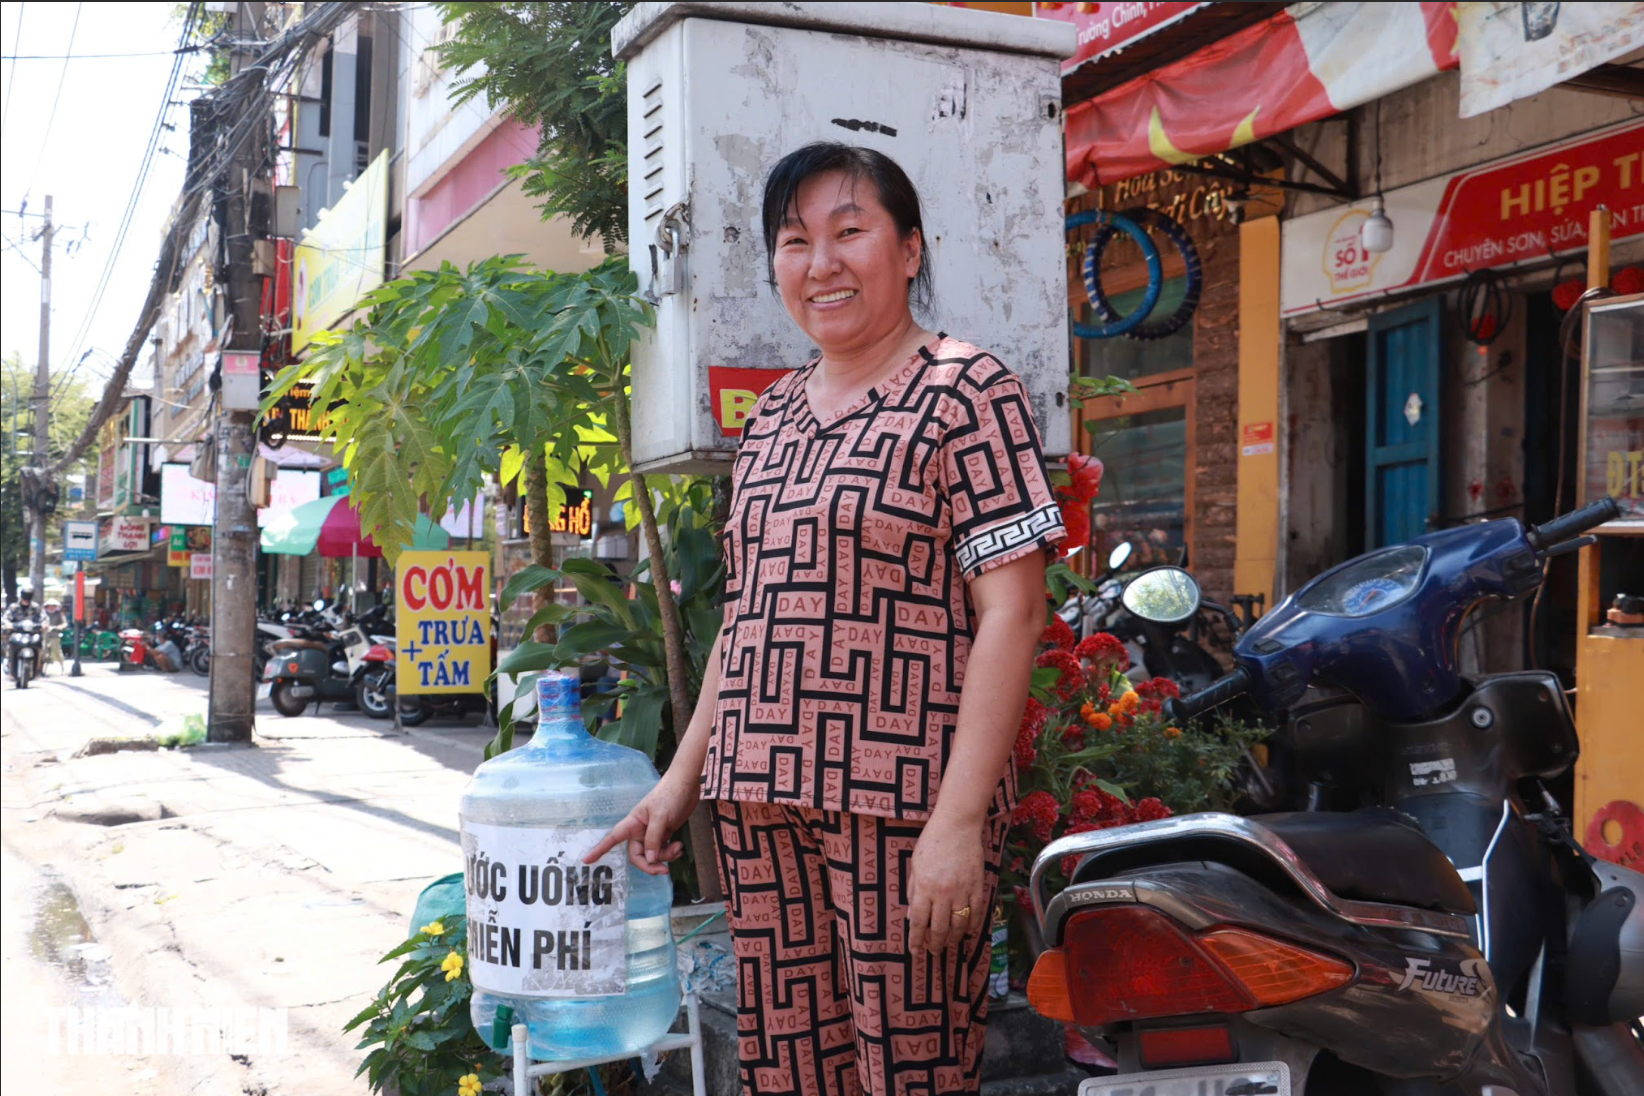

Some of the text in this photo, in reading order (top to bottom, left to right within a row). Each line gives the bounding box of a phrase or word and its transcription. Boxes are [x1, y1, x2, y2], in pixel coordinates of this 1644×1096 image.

[1501, 163, 1600, 220] HIỆP
[1613, 152, 1644, 189] T
[1443, 237, 1503, 268] CHUYÊN
[1507, 230, 1546, 254] SƠN,
[1550, 217, 1588, 244] SỬA,
[1335, 242, 1356, 268] SỐ
[987, 382, 1016, 398] DAY
[884, 416, 917, 429] DAY
[977, 402, 998, 440] DAY
[1005, 406, 1024, 438] DAY
[820, 441, 834, 462] DAY
[951, 433, 977, 450] DAY
[739, 458, 749, 477] DAY
[805, 449, 816, 469] DAY
[845, 459, 877, 468] DAY
[912, 453, 920, 475] DAY
[994, 449, 1014, 488] DAY
[1019, 453, 1038, 484] DAY
[886, 469, 897, 489] DAY
[968, 457, 987, 488] DAY
[750, 485, 776, 495] DAY
[787, 487, 813, 499] DAY
[817, 485, 833, 517] DAY
[891, 492, 929, 510] DAY
[982, 493, 1014, 509] DAY
[749, 504, 760, 532] DAY
[839, 494, 854, 523] DAY
[774, 517, 791, 528] DAY
[862, 516, 872, 542] DAY
[876, 520, 903, 533] DAY
[907, 522, 932, 533] DAY
[770, 536, 790, 546] DAY
[798, 529, 807, 559] DAY
[817, 529, 826, 567] DAY
[873, 541, 900, 553] DAY
[838, 539, 849, 572] DAY
[911, 545, 924, 573] DAY
[760, 561, 786, 577] DAY
[863, 563, 900, 583] DAY
[403, 557, 485, 611] CƠM
[837, 580, 848, 611] DAY
[861, 581, 869, 611] DAY
[779, 597, 823, 612] DAY
[898, 607, 944, 626] DAY
[952, 598, 963, 628] DAY
[418, 616, 485, 645] TRƯA
[743, 624, 765, 639] DAY
[774, 627, 805, 638] DAY
[849, 627, 882, 644] DAY
[805, 632, 819, 678] DAY
[832, 625, 845, 665] DAY
[895, 637, 928, 651] DAY
[418, 650, 470, 686] TẤM
[784, 652, 793, 677] DAY
[871, 659, 880, 681] DAY
[932, 646, 942, 692] DAY
[955, 640, 965, 680] DAY
[820, 681, 854, 691] DAY
[891, 672, 899, 694] DAY
[910, 663, 919, 689] DAY
[782, 679, 791, 705] DAY
[869, 691, 877, 713] DAY
[908, 690, 918, 716] DAY
[756, 708, 787, 720] DAY
[818, 701, 854, 712] DAY
[801, 711, 814, 749] DAY
[876, 716, 912, 731] DAY
[746, 741, 767, 750] DAY
[770, 736, 794, 744] DAY
[829, 723, 840, 756] DAY
[895, 746, 920, 755] DAY
[928, 724, 939, 761] DAY
[736, 741, 744, 767] DAY
[744, 761, 767, 770] DAY
[852, 747, 861, 773] DAY
[864, 749, 891, 759] DAY
[778, 757, 788, 787] DAY
[801, 760, 812, 798] DAY
[863, 768, 892, 780] DAY
[906, 769, 916, 799] DAY
[733, 787, 764, 801] DAY
[824, 771, 838, 803] DAY
[746, 807, 770, 819] DAY
[852, 794, 890, 811] DAY
[778, 831, 793, 860] DAY
[741, 865, 771, 879] DAY
[865, 848, 875, 881] DAY
[889, 852, 899, 892] DAY
[518, 850, 613, 906] UỐNG
[785, 866, 799, 894] DAY
[809, 866, 822, 900] DAY
[743, 895, 768, 904] DAY
[1070, 889, 1133, 902] HONDA
[746, 913, 769, 922] DAY
[771, 896, 781, 920] DAY
[864, 897, 874, 929] DAY
[791, 908, 804, 938] DAY
[817, 910, 829, 943] DAY
[890, 904, 902, 942] DAY
[533, 921, 592, 971] PHÍ
[735, 941, 762, 952] DAY
[783, 947, 816, 959] DAY
[856, 943, 886, 952] DAY
[763, 954, 771, 974] DAY
[785, 966, 816, 977] DAY
[858, 963, 886, 974] DAY
[765, 984, 773, 1004] DAY
[821, 972, 831, 1014] DAY
[891, 975, 902, 1023] DAY
[916, 975, 924, 1001] DAY
[797, 989, 810, 1029] DAY
[867, 990, 882, 1033] DAY
[906, 1013, 941, 1026] DAY
[767, 1016, 796, 1030] DAY
[781, 1044, 791, 1071] DAY
[801, 1039, 813, 1067] DAY
[895, 1038, 937, 1058] DAY
[871, 1045, 883, 1079] DAY
[760, 1073, 791, 1087] DAY
